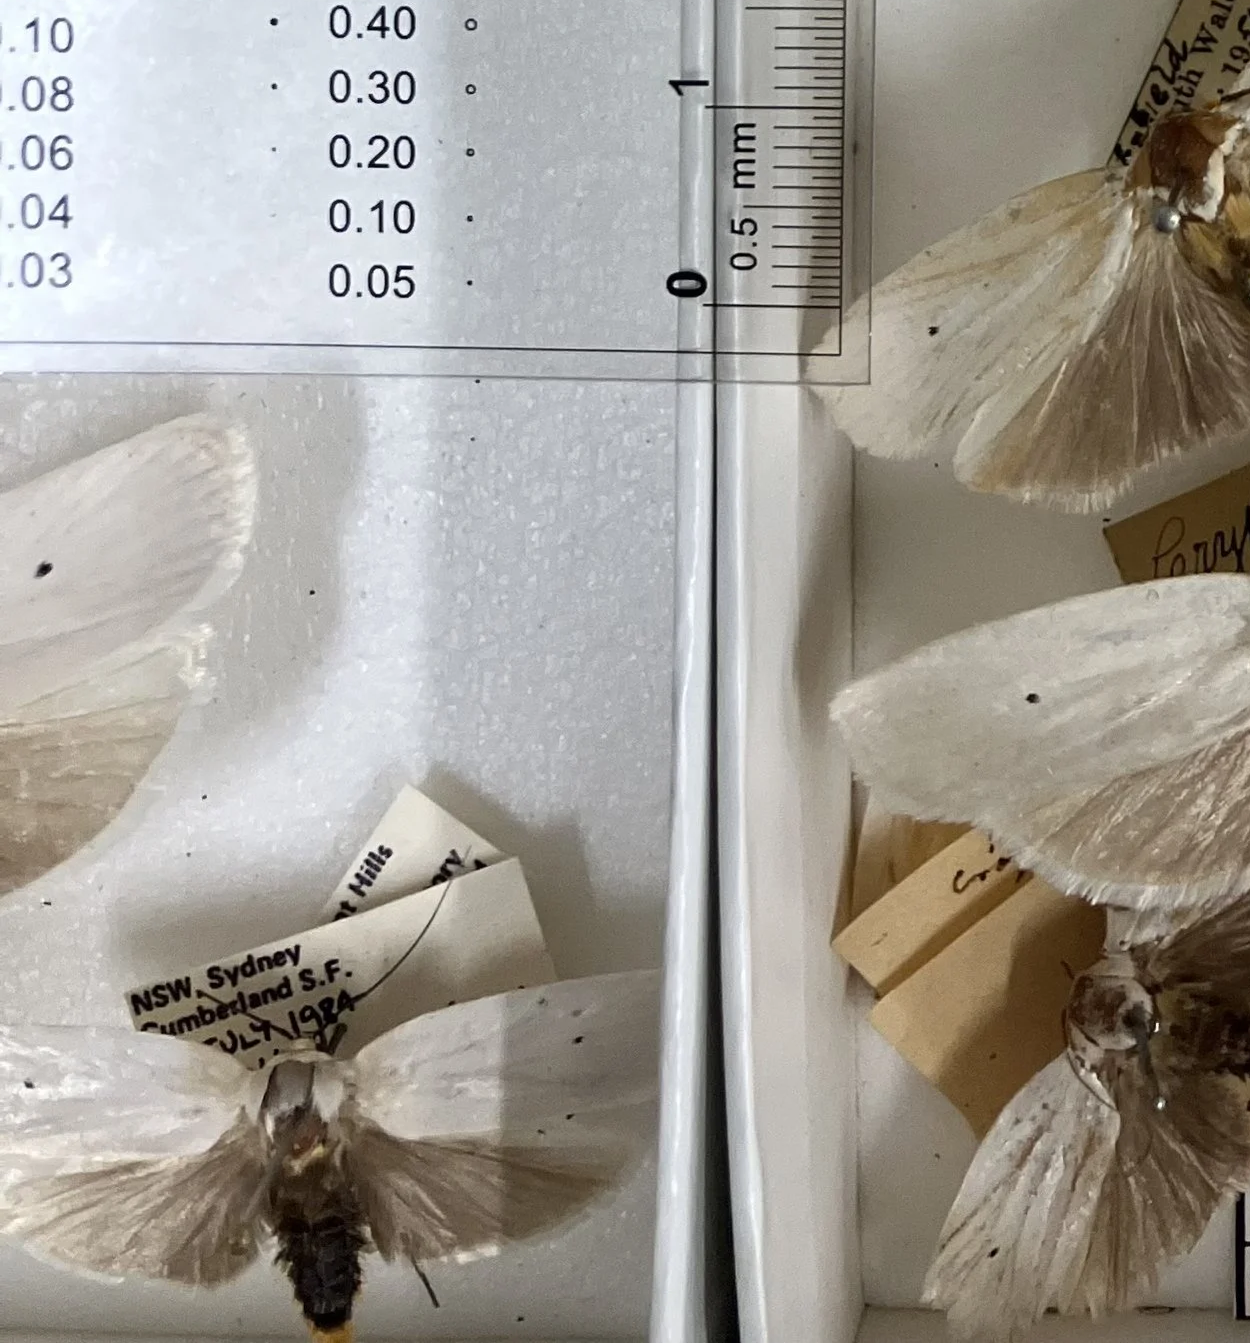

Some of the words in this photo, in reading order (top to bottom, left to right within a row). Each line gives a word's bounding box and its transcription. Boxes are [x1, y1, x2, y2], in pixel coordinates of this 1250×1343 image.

[0, 17, 74, 54] .10
[329, 5, 416, 40] 0.40
[0, 76, 74, 113] .08
[329, 69, 416, 105] 0.30
[670, 78, 710, 97] 1
[0, 134, 74, 171] .06
[329, 134, 416, 169] 0.20
[733, 122, 756, 190] mm
[0, 193, 73, 230] .04
[329, 199, 415, 234] 0.10
[730, 216, 758, 272] 0.5
[0, 252, 72, 289] .03
[329, 263, 415, 298] 0.05
[665, 269, 708, 299] 0
[347, 844, 394, 898] Mills
[206, 944, 302, 989] Sydney
[298, 958, 353, 992] S.F.
